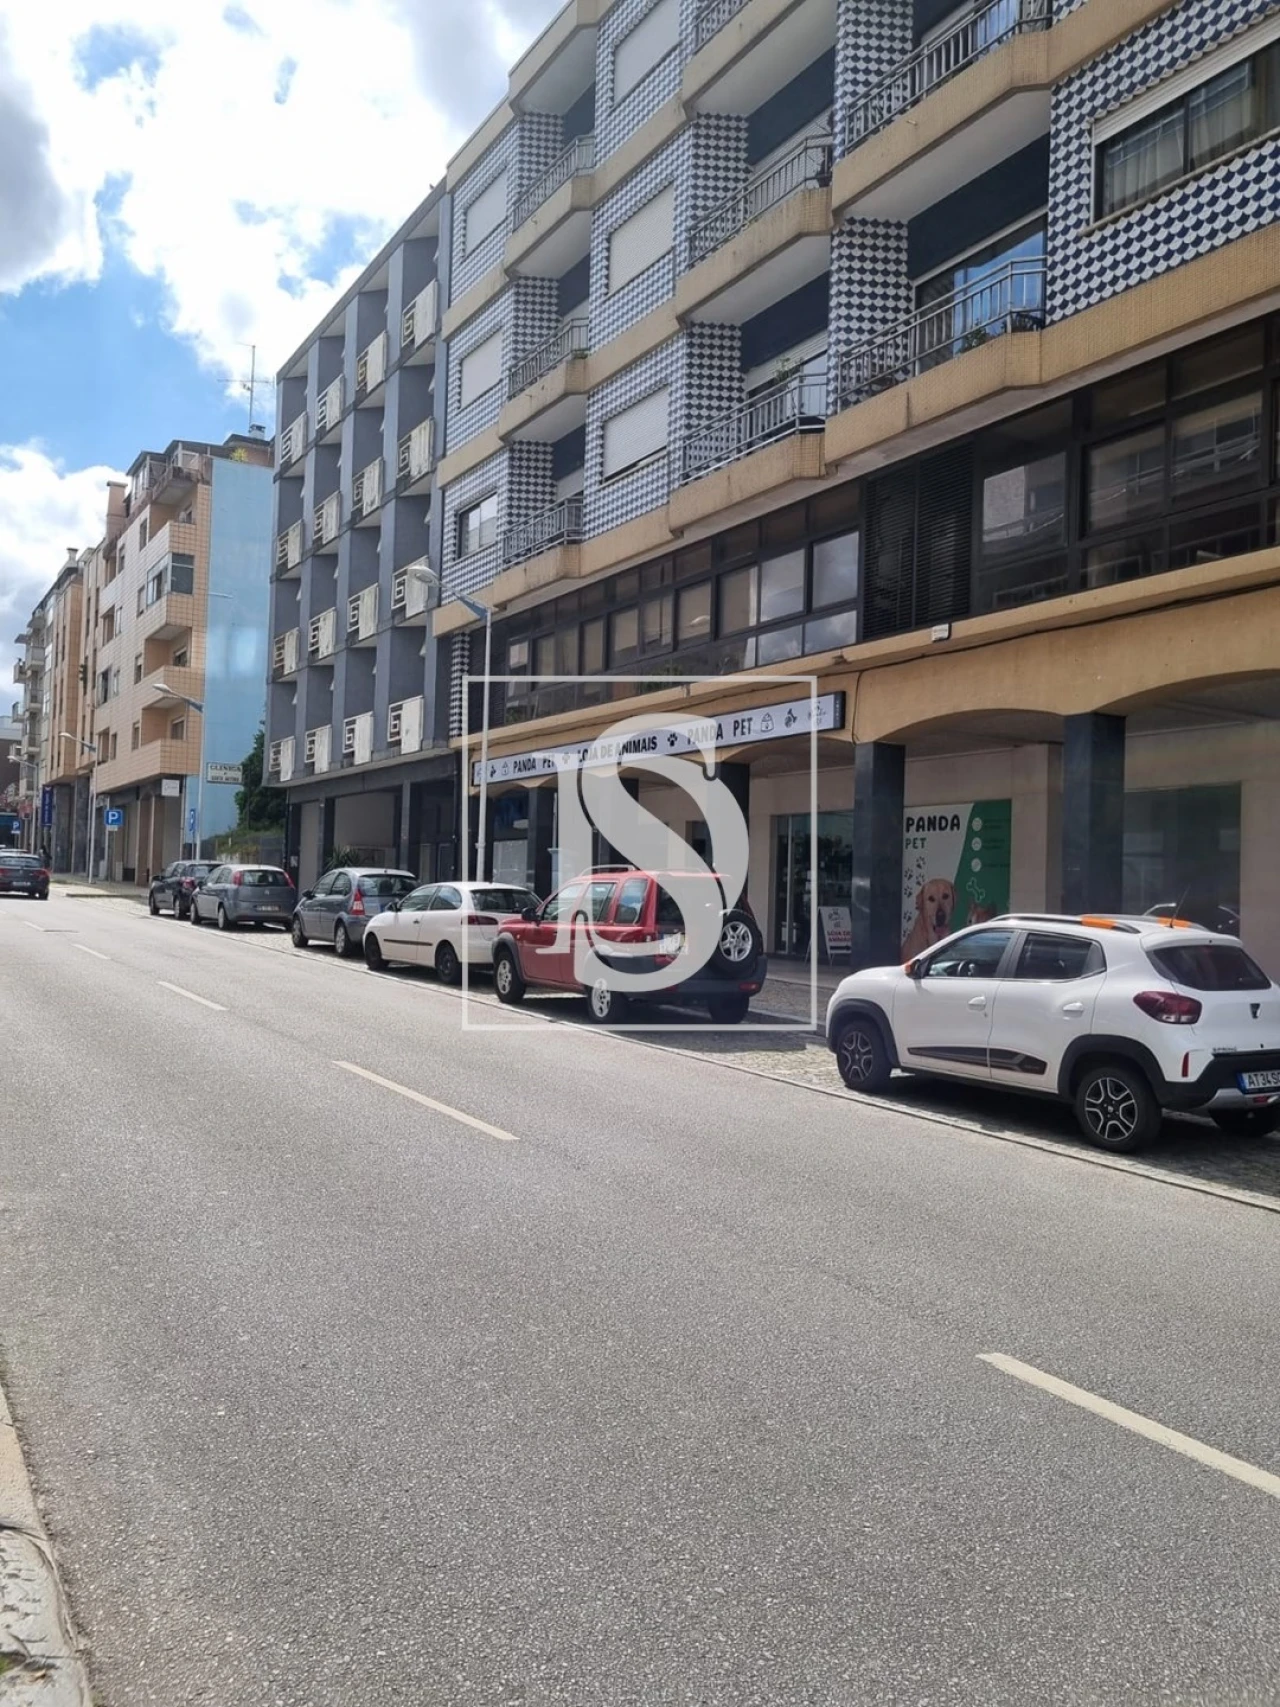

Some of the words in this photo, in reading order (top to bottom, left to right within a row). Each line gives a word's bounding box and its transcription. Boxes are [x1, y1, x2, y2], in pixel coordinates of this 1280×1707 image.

[512, 757, 537, 774] PANDA
[543, 755, 555, 770] PET
[601, 745, 614, 760] DE
[615, 735, 658, 757] ANIMAIS
[687, 722, 724, 746] PANDA
[733, 716, 753, 738] PET
[108, 811, 119, 824] P
[905, 814, 961, 834] PANDA
[905, 836, 927, 850] PET
